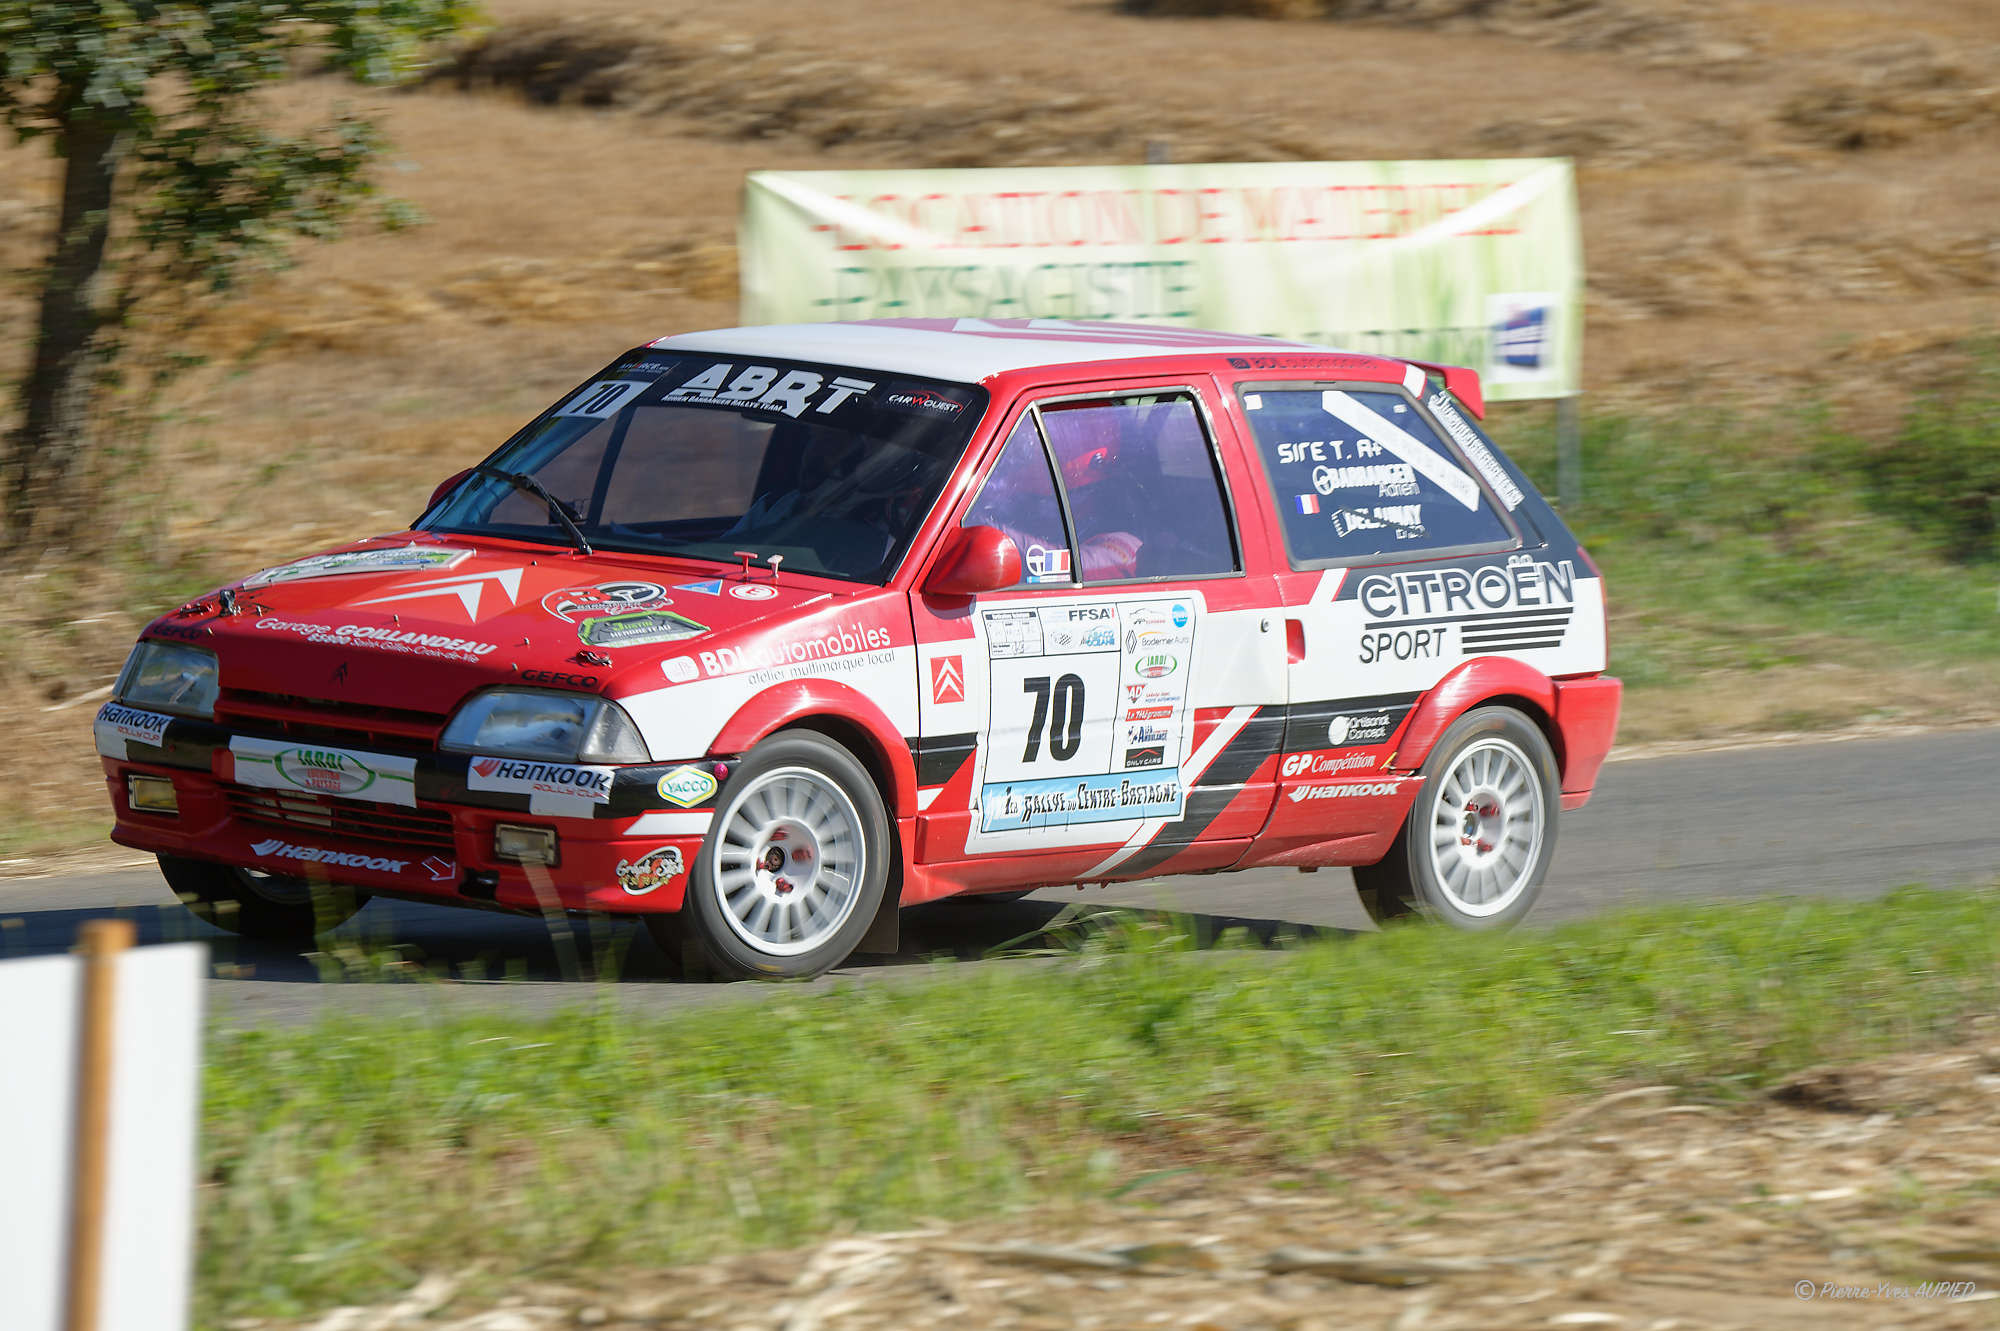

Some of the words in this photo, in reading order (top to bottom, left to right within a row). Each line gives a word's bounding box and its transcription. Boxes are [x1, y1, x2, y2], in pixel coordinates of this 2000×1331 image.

[569, 383, 631, 415] 70
[661, 363, 877, 418] ABRT
[759, 402, 783, 413] TEAM
[1357, 554, 1577, 619] CITROËN
[1068, 608, 1110, 622] FFSA
[255, 616, 331, 636] Garage
[335, 625, 499, 655] GOILLANDEAU
[1359, 627, 1447, 664] SPORT
[868, 650, 896, 666] local
[521, 669, 598, 688] GEFCO
[1128, 685, 1144, 699] AD
[1022, 673, 1085, 763] 70
[1282, 754, 1313, 777] GP
[1312, 752, 1377, 776] Compétition
[666, 780, 709, 794] YACCO
[1021, 793, 1066, 822] RALLYE
